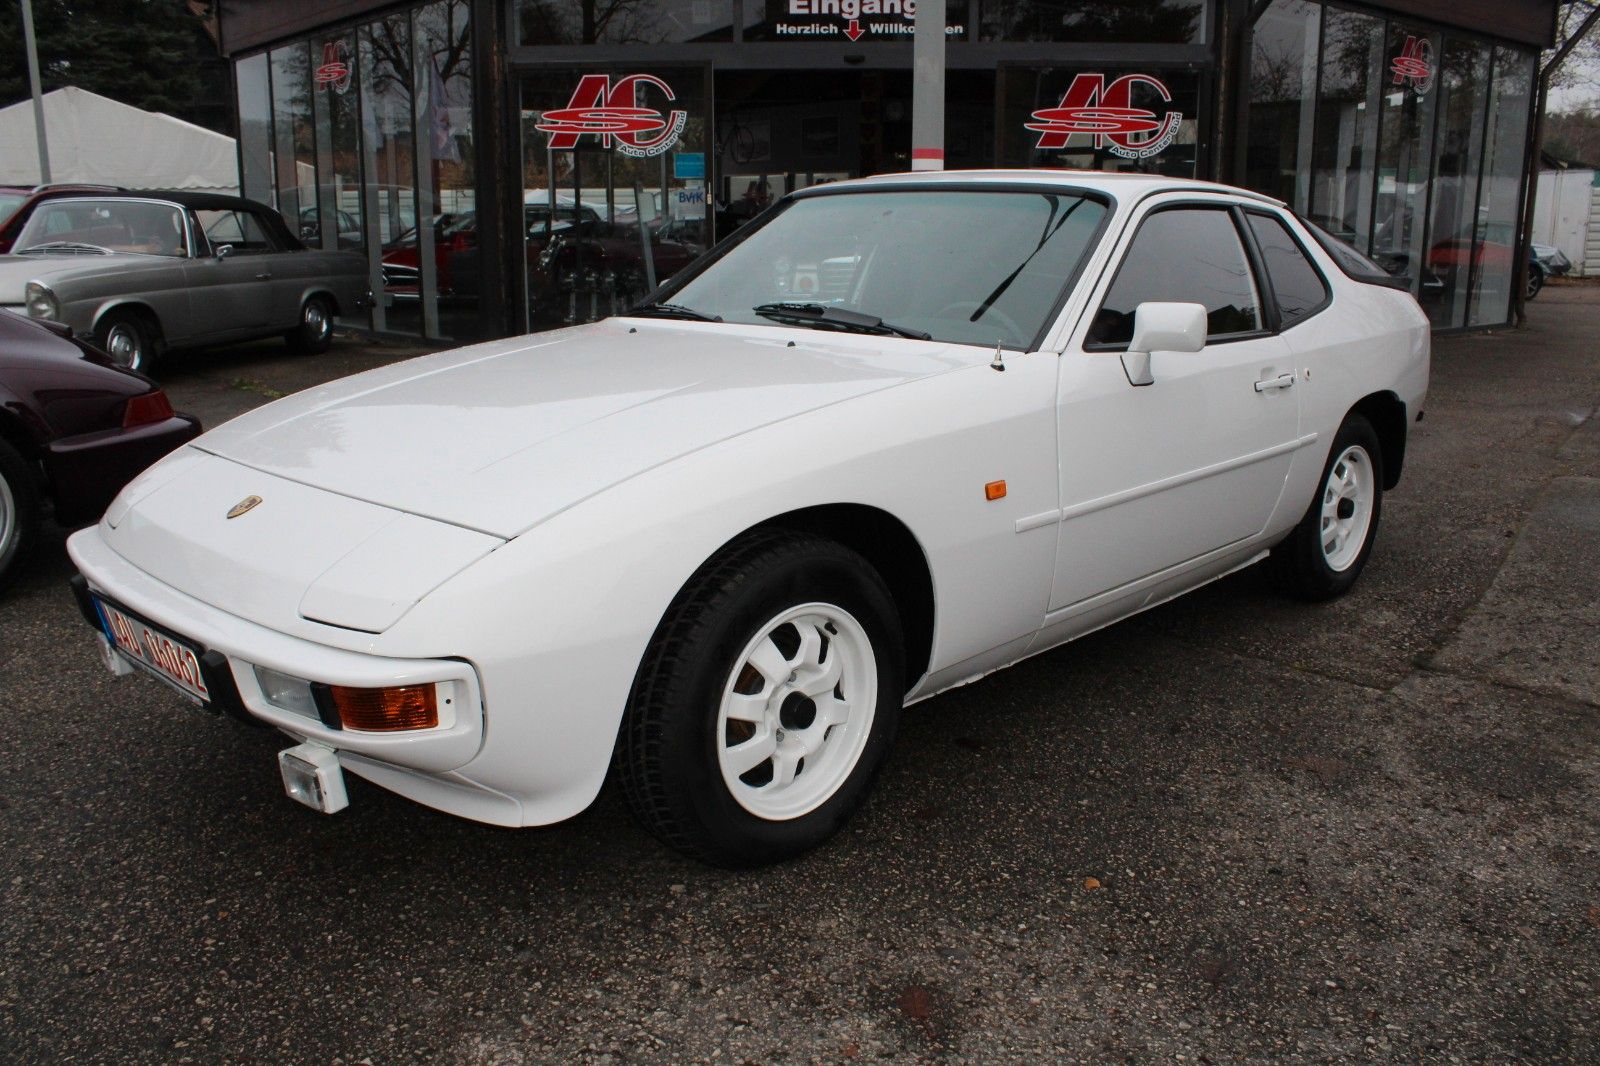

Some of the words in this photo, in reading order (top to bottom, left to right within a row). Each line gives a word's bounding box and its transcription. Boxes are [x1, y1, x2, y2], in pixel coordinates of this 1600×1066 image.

[776, 23, 839, 34] Herzlich
[870, 23, 964, 34] Willkoen
[619, 144, 646, 157] Auto
[647, 133, 678, 156] Center
[1110, 145, 1138, 158] Auto
[1139, 135, 1172, 158] Center
[143, 628, 208, 693] 06062
